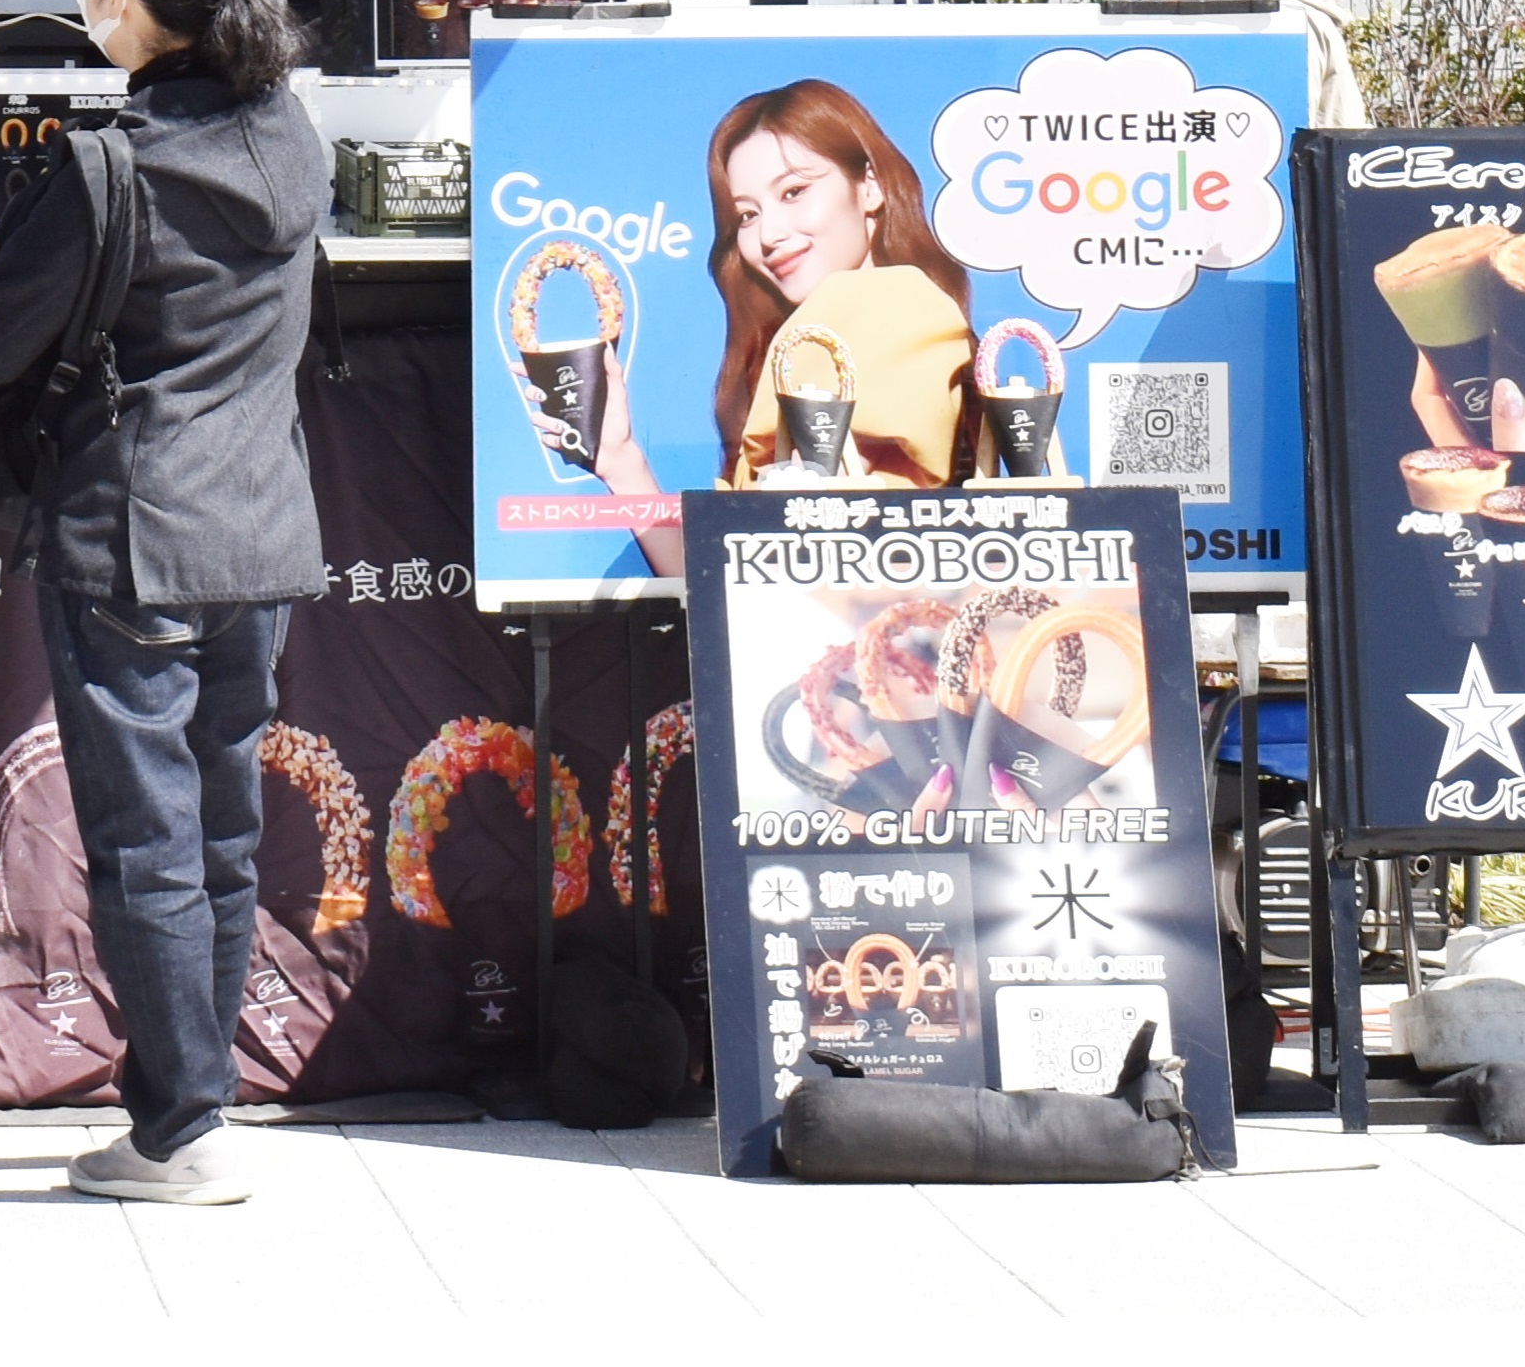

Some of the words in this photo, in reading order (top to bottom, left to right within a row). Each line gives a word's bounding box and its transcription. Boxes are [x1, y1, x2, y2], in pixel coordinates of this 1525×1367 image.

[1018, 110, 1217, 143] TWICE出演
[972, 150, 1231, 226] Google
[491, 171, 693, 263] Google
[784, 496, 1068, 530] 米粉チュロス専門店
[727, 532, 1132, 587] KUROBOSHI
[1185, 528, 1281, 561] OSHI
[732, 814, 861, 848] 100%
[867, 811, 1045, 846] GLUTEN
[1059, 808, 1170, 843] FREE
[759, 876, 800, 913] 米
[819, 871, 955, 908] 粉で作り
[1032, 863, 1115, 940] 米
